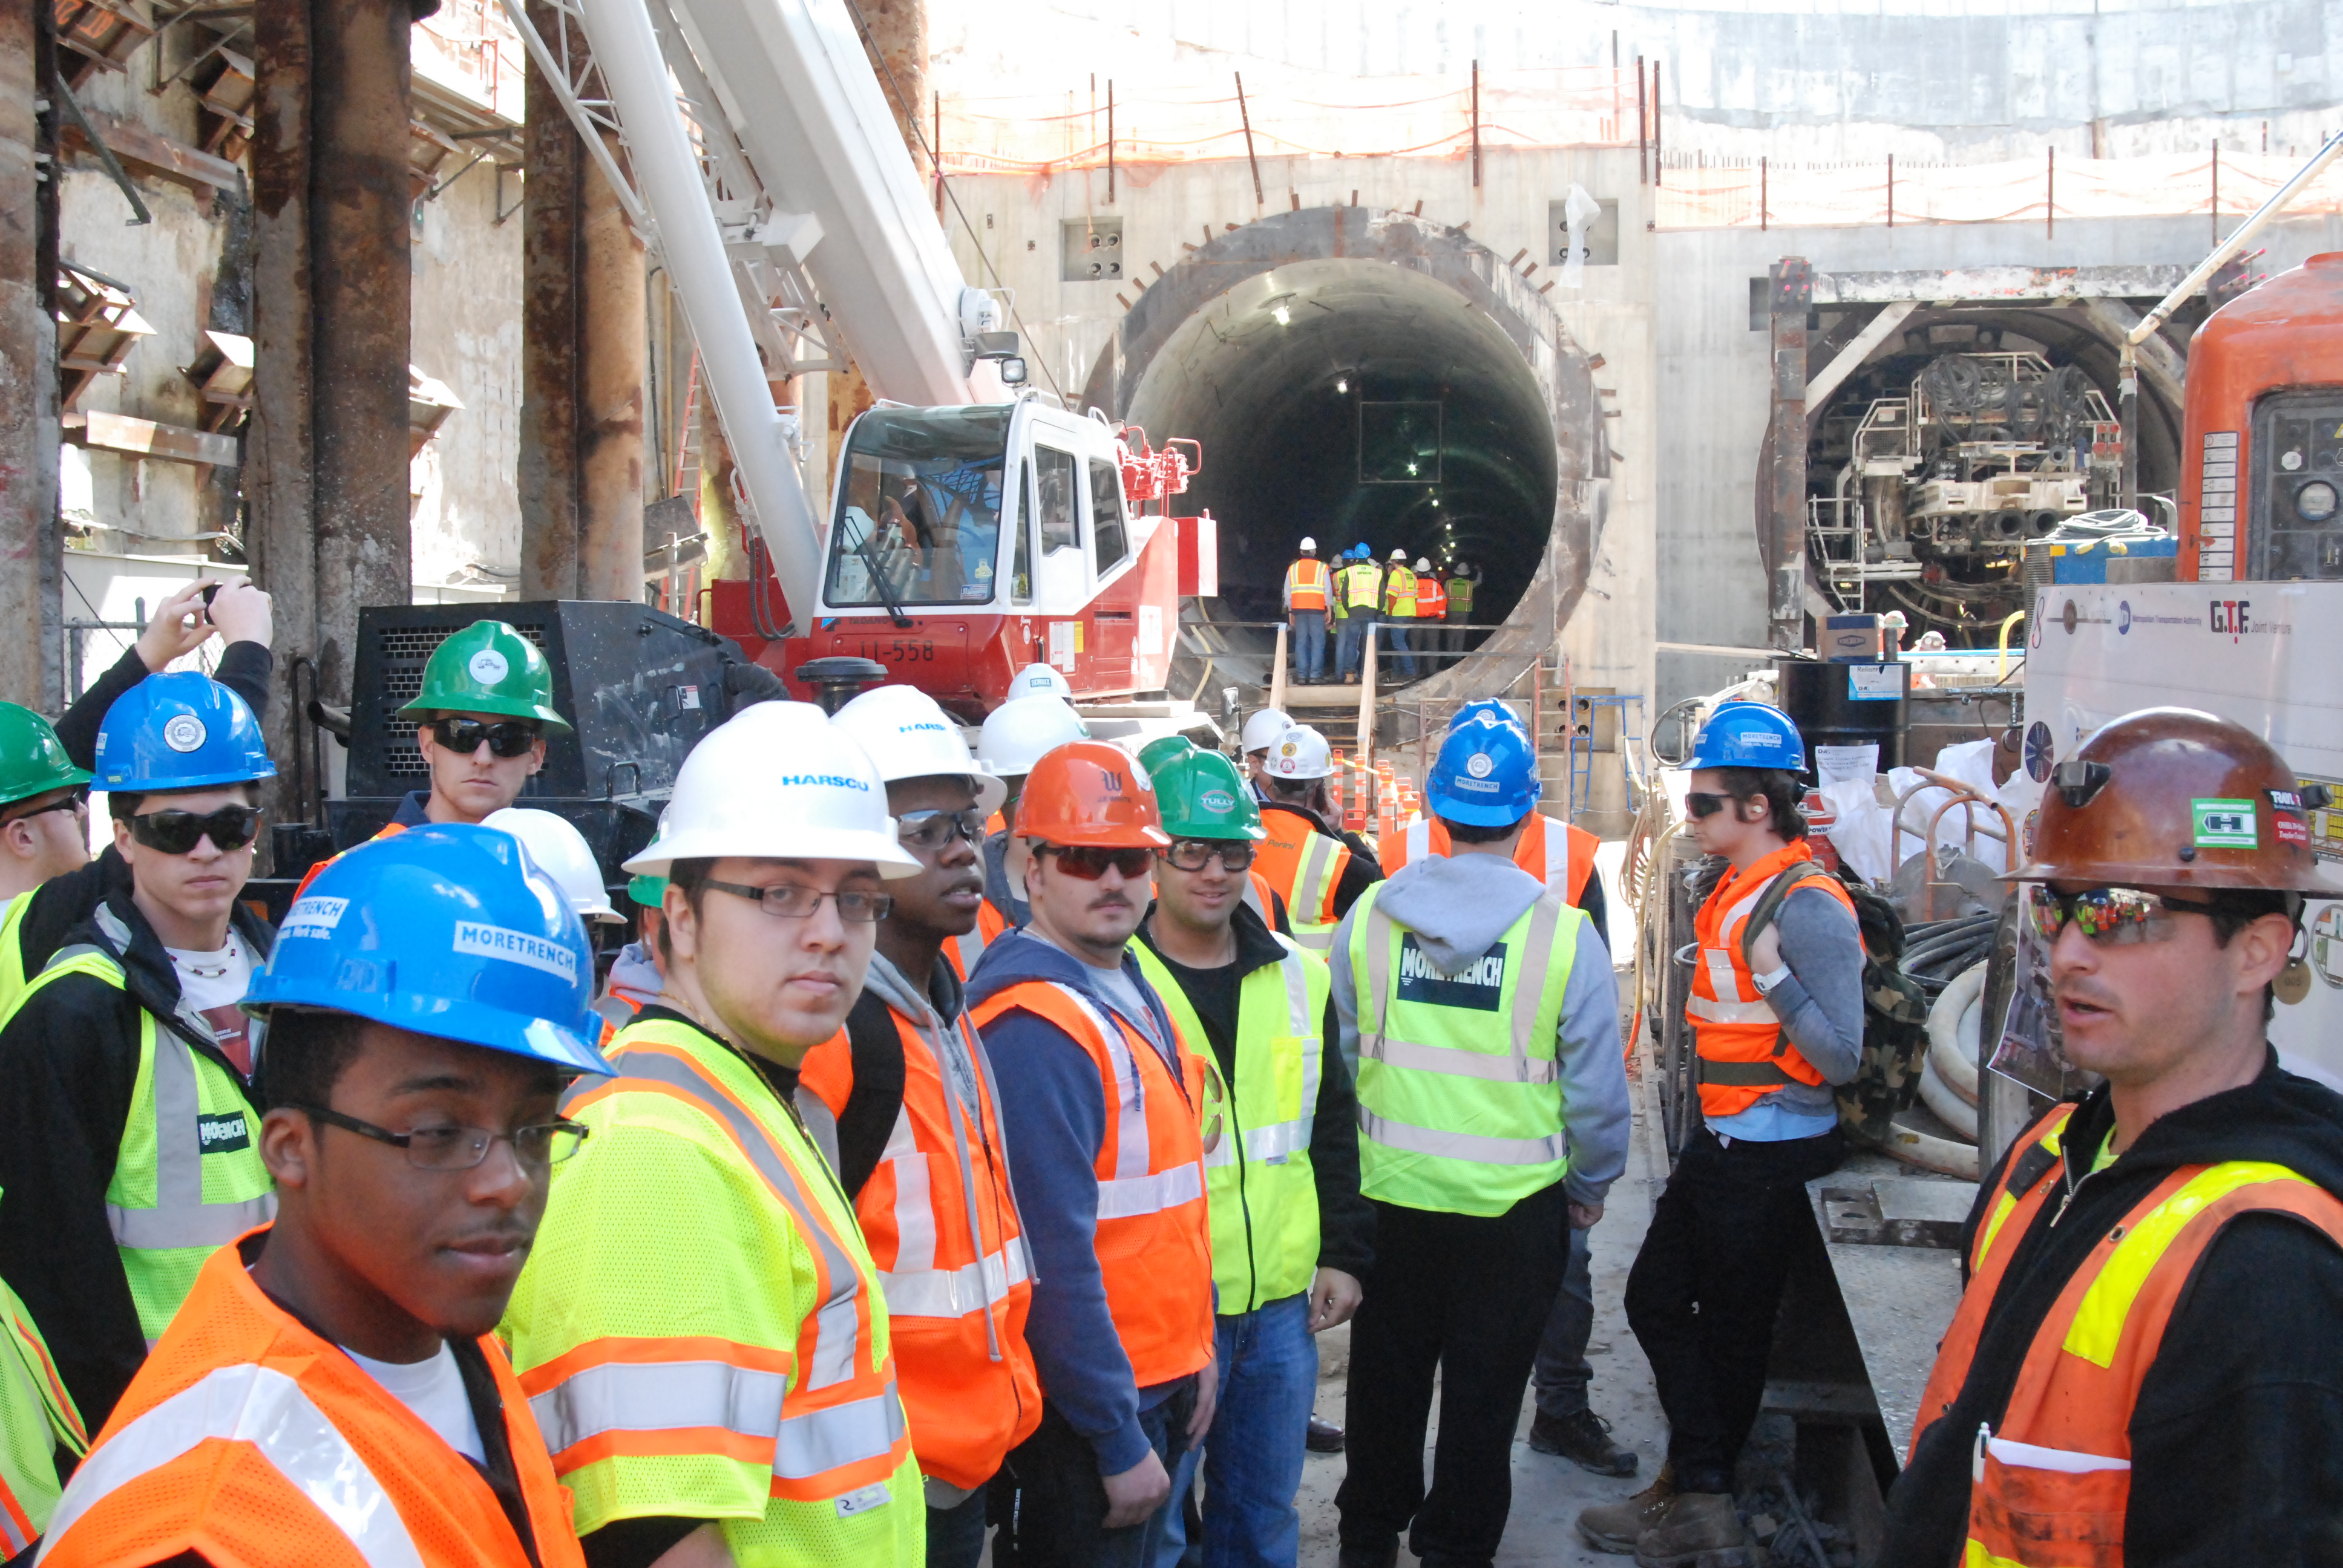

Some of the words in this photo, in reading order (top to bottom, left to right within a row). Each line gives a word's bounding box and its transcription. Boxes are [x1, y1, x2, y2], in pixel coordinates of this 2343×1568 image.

[2155, 615, 2182, 624] Transportation
[2183, 616, 2201, 626] Authority
[2250, 621, 2267, 633] Joint
[1457, 777, 1499, 789] MORETRENCH
[1201, 798, 1235, 806] TULLY
[462, 926, 574, 970] MORETRENCH
